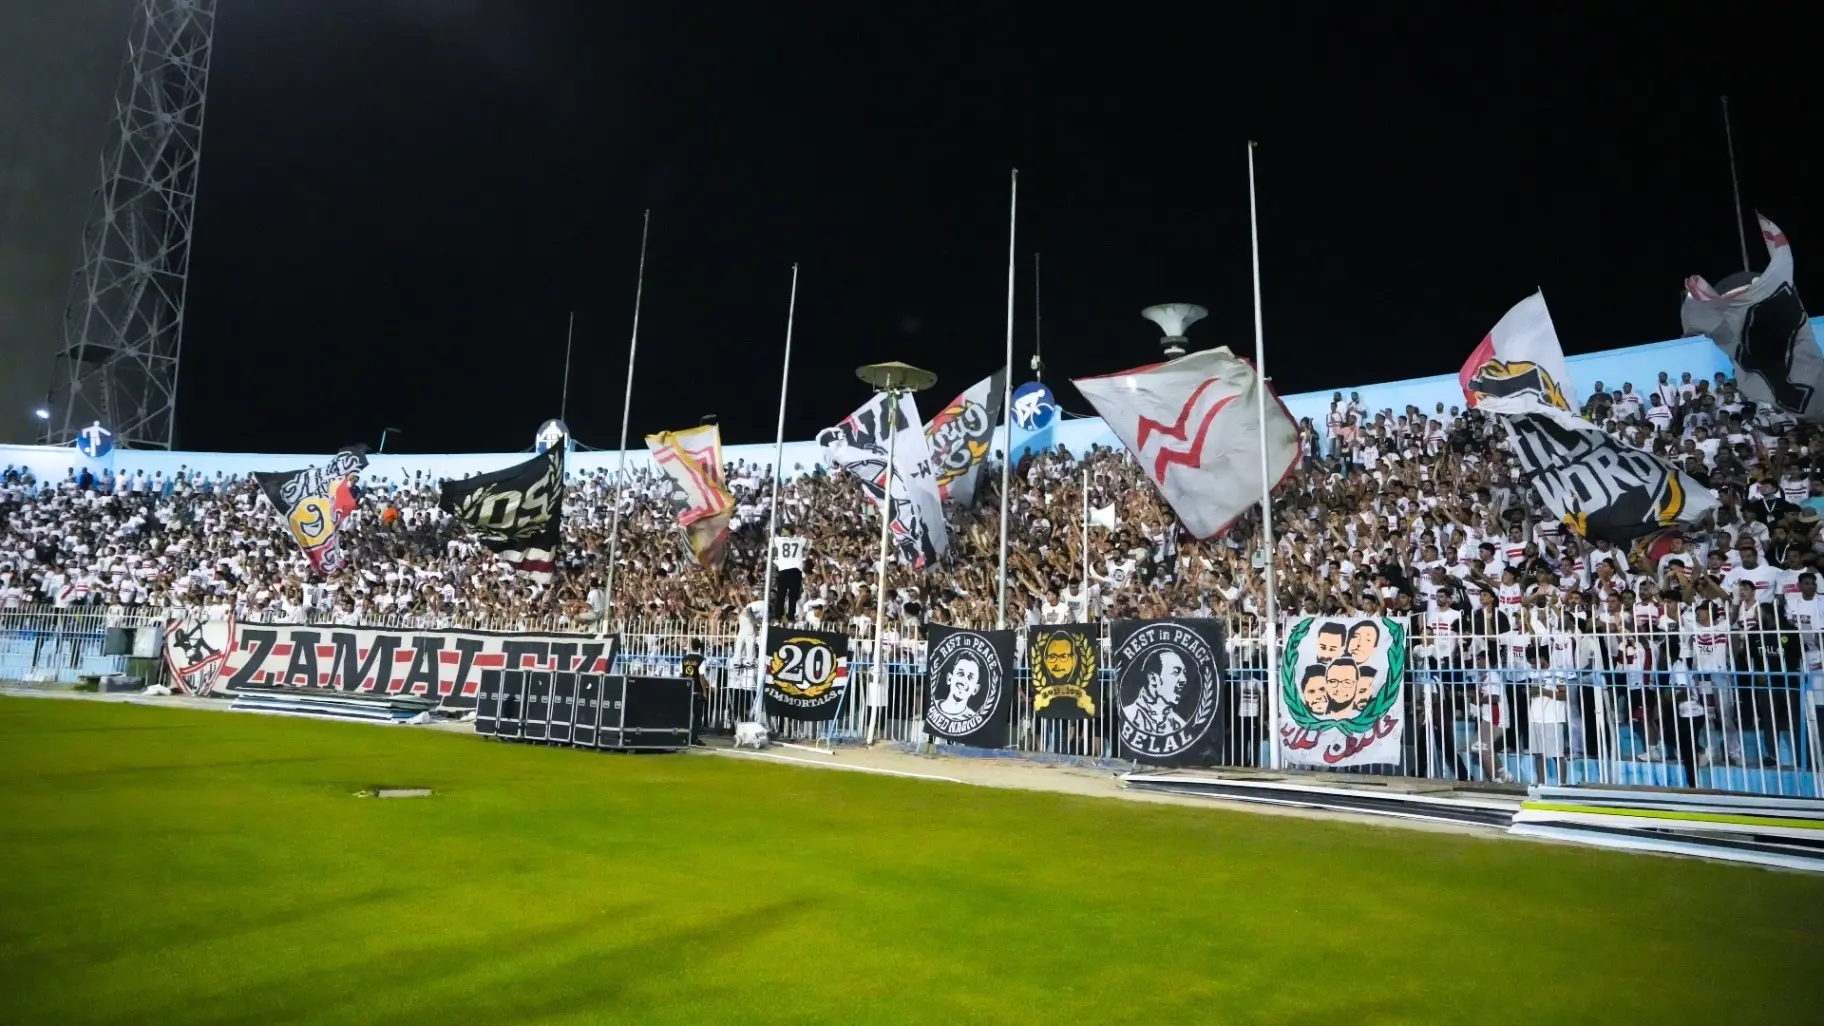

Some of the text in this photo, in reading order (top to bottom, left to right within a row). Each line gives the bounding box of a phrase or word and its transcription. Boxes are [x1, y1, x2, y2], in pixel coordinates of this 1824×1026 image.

[782, 543, 799, 558] 87
[940, 636, 997, 669] REST in PEACE
[1123, 630, 1210, 665] REST in PEACE
[778, 645, 832, 684] 20
[769, 688, 838, 707] IMMORTALS
[1122, 721, 1193, 753] BELAL
